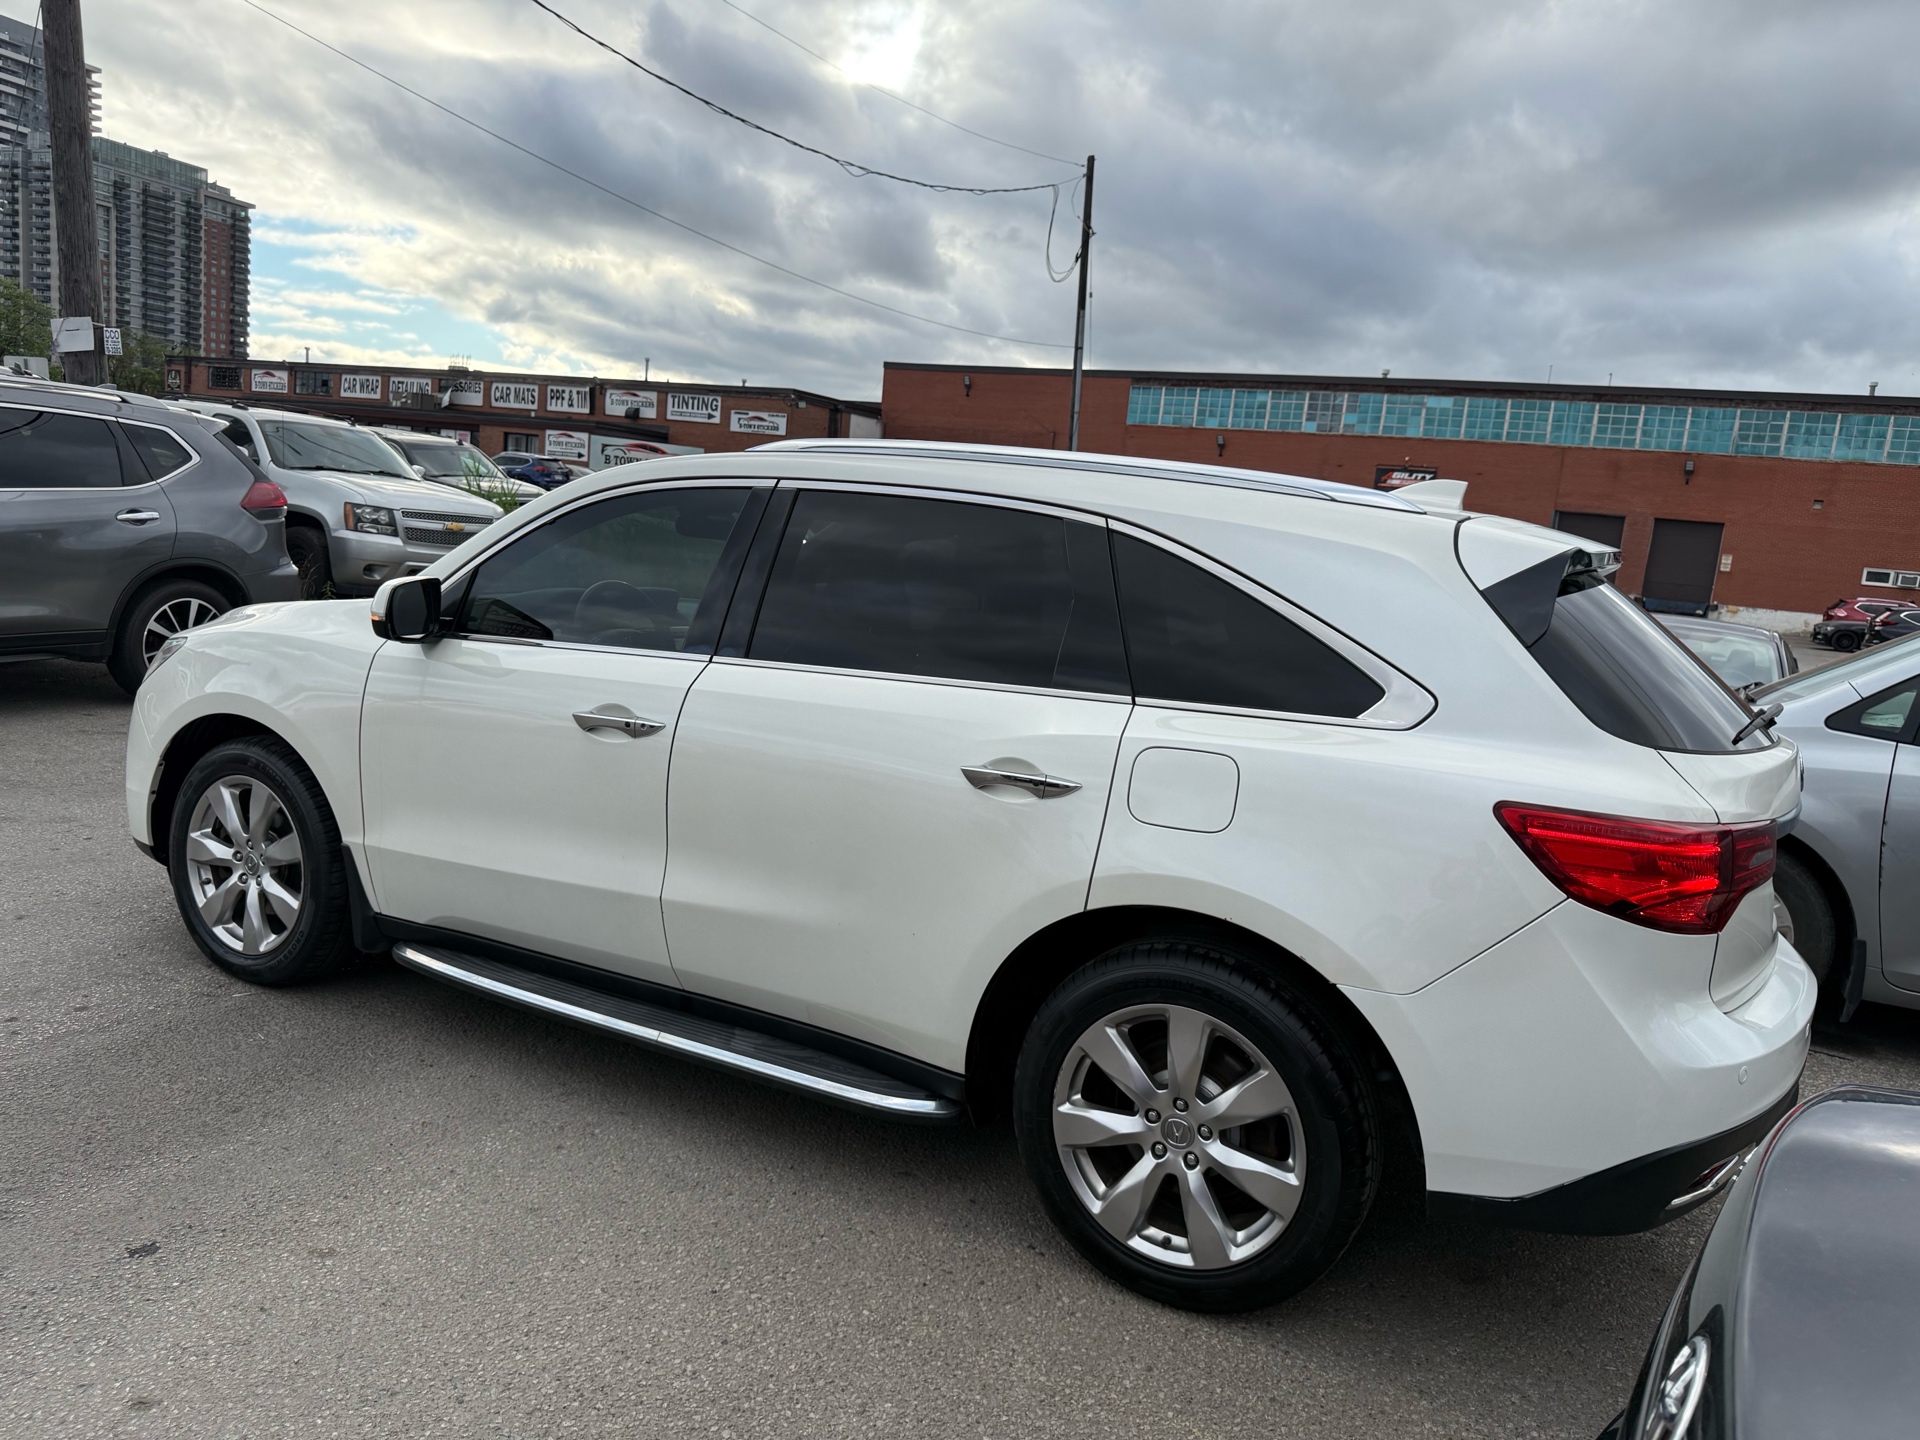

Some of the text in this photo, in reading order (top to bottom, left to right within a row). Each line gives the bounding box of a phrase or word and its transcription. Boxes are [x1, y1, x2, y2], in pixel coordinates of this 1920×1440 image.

[343, 377, 379, 395] CAR WRAP
[494, 385, 536, 405] CAR MATS
[550, 388, 566, 407] PPF
[567, 389, 575, 408] &
[671, 394, 719, 412] TINTING
[1381, 471, 1435, 481] AGILITY
